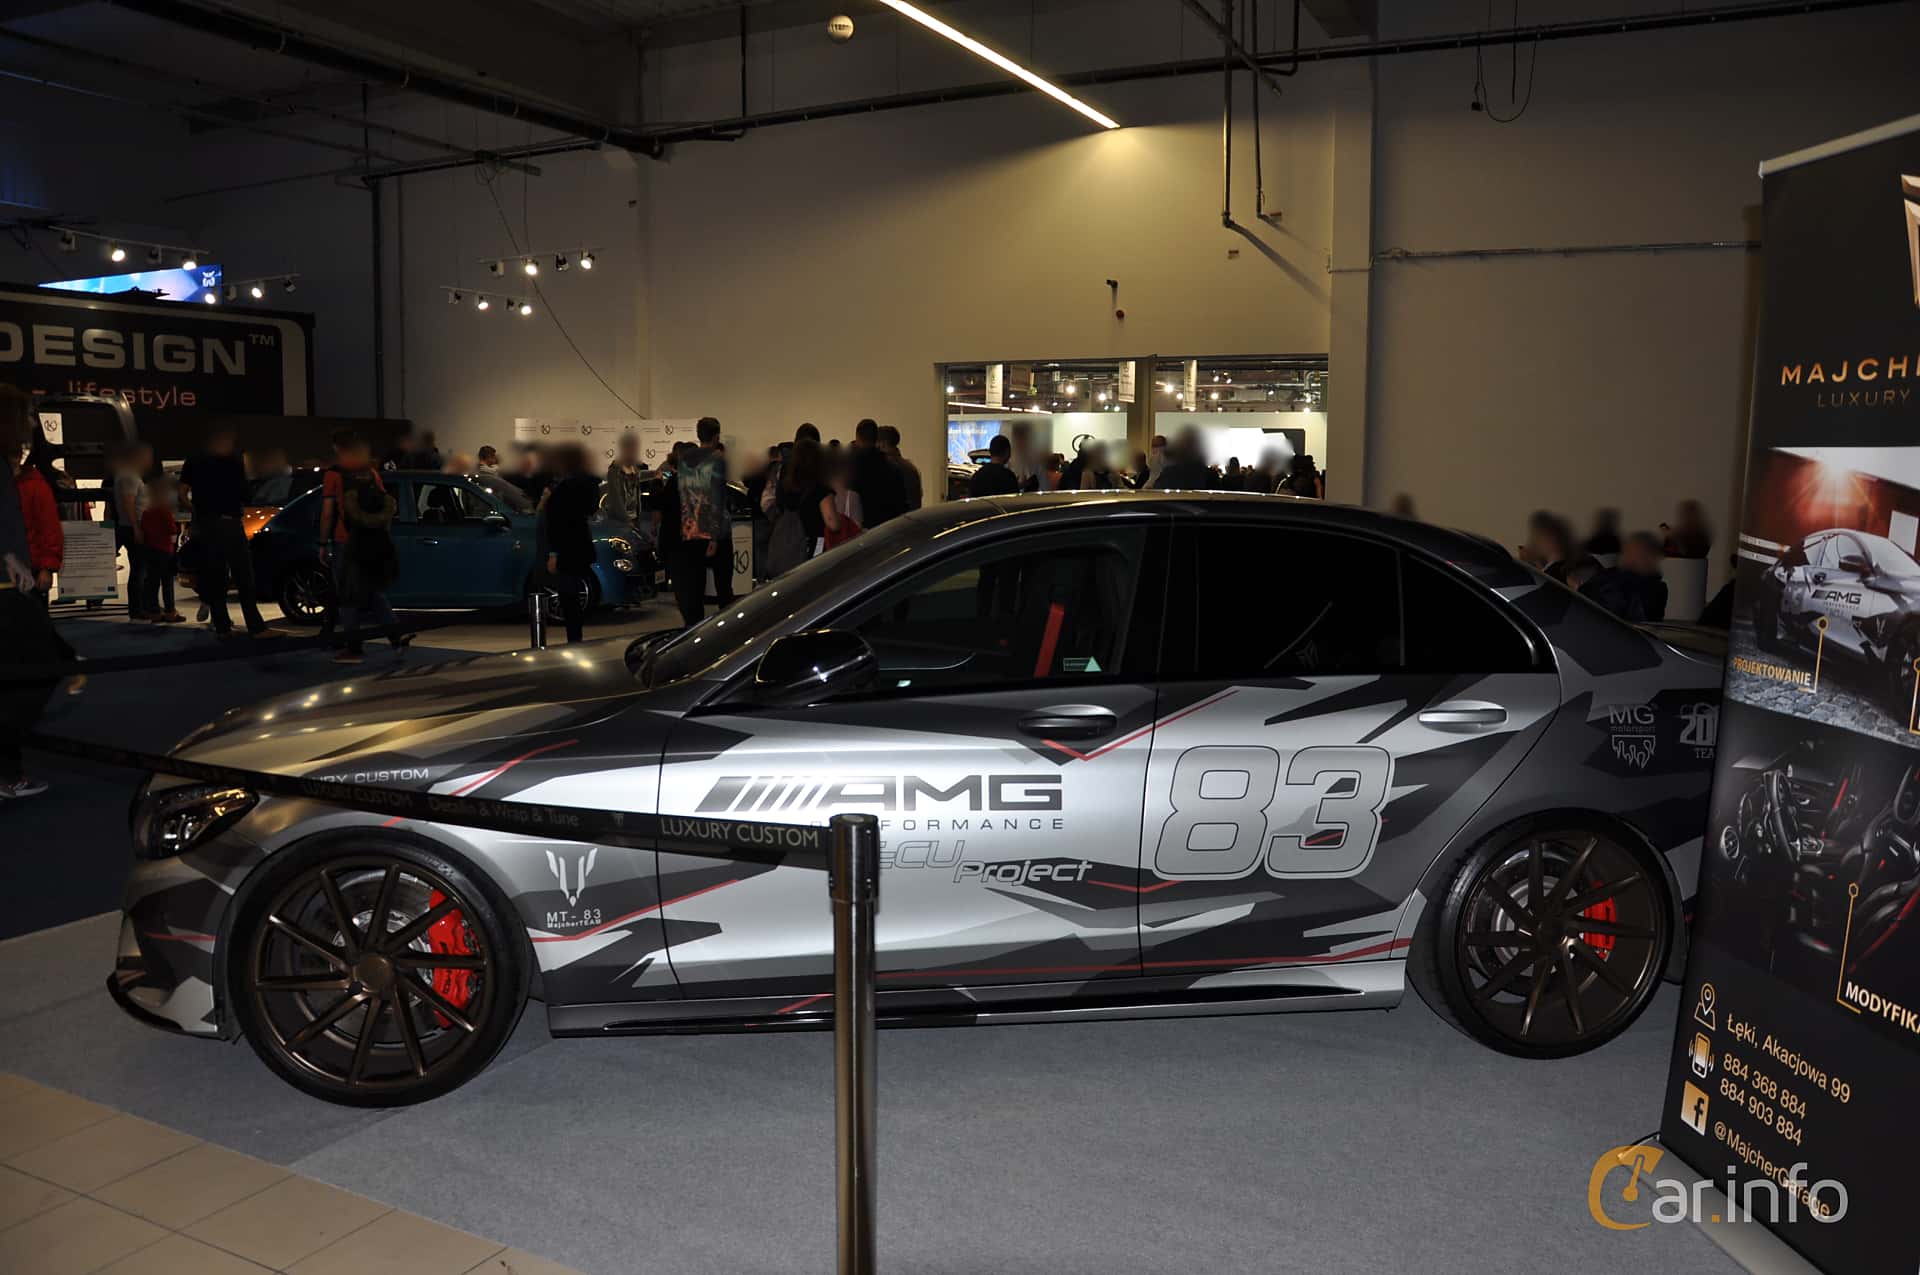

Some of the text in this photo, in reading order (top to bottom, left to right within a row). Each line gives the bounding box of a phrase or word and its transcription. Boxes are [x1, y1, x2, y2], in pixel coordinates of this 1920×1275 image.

[1781, 354, 1920, 386] MAJCH
[1817, 388, 1911, 408] LUXURY
[1733, 656, 1812, 687] PROJEKTOWANIE
[354, 767, 429, 784] CUSTOM
[816, 774, 1063, 812] AMG
[811, 819, 1064, 831] PFORMANCE
[1152, 744, 1396, 881] 83
[660, 817, 820, 849] LUXURY CUSTOM
[953, 859, 1093, 886] Project
[1845, 981, 1920, 1034] MODYFIK
[1727, 1013, 1851, 1104] Łęki, Akacjowa 99
[1723, 1053, 1806, 1120] 884 368 884
[1720, 1078, 1802, 1147] 884 903 884
